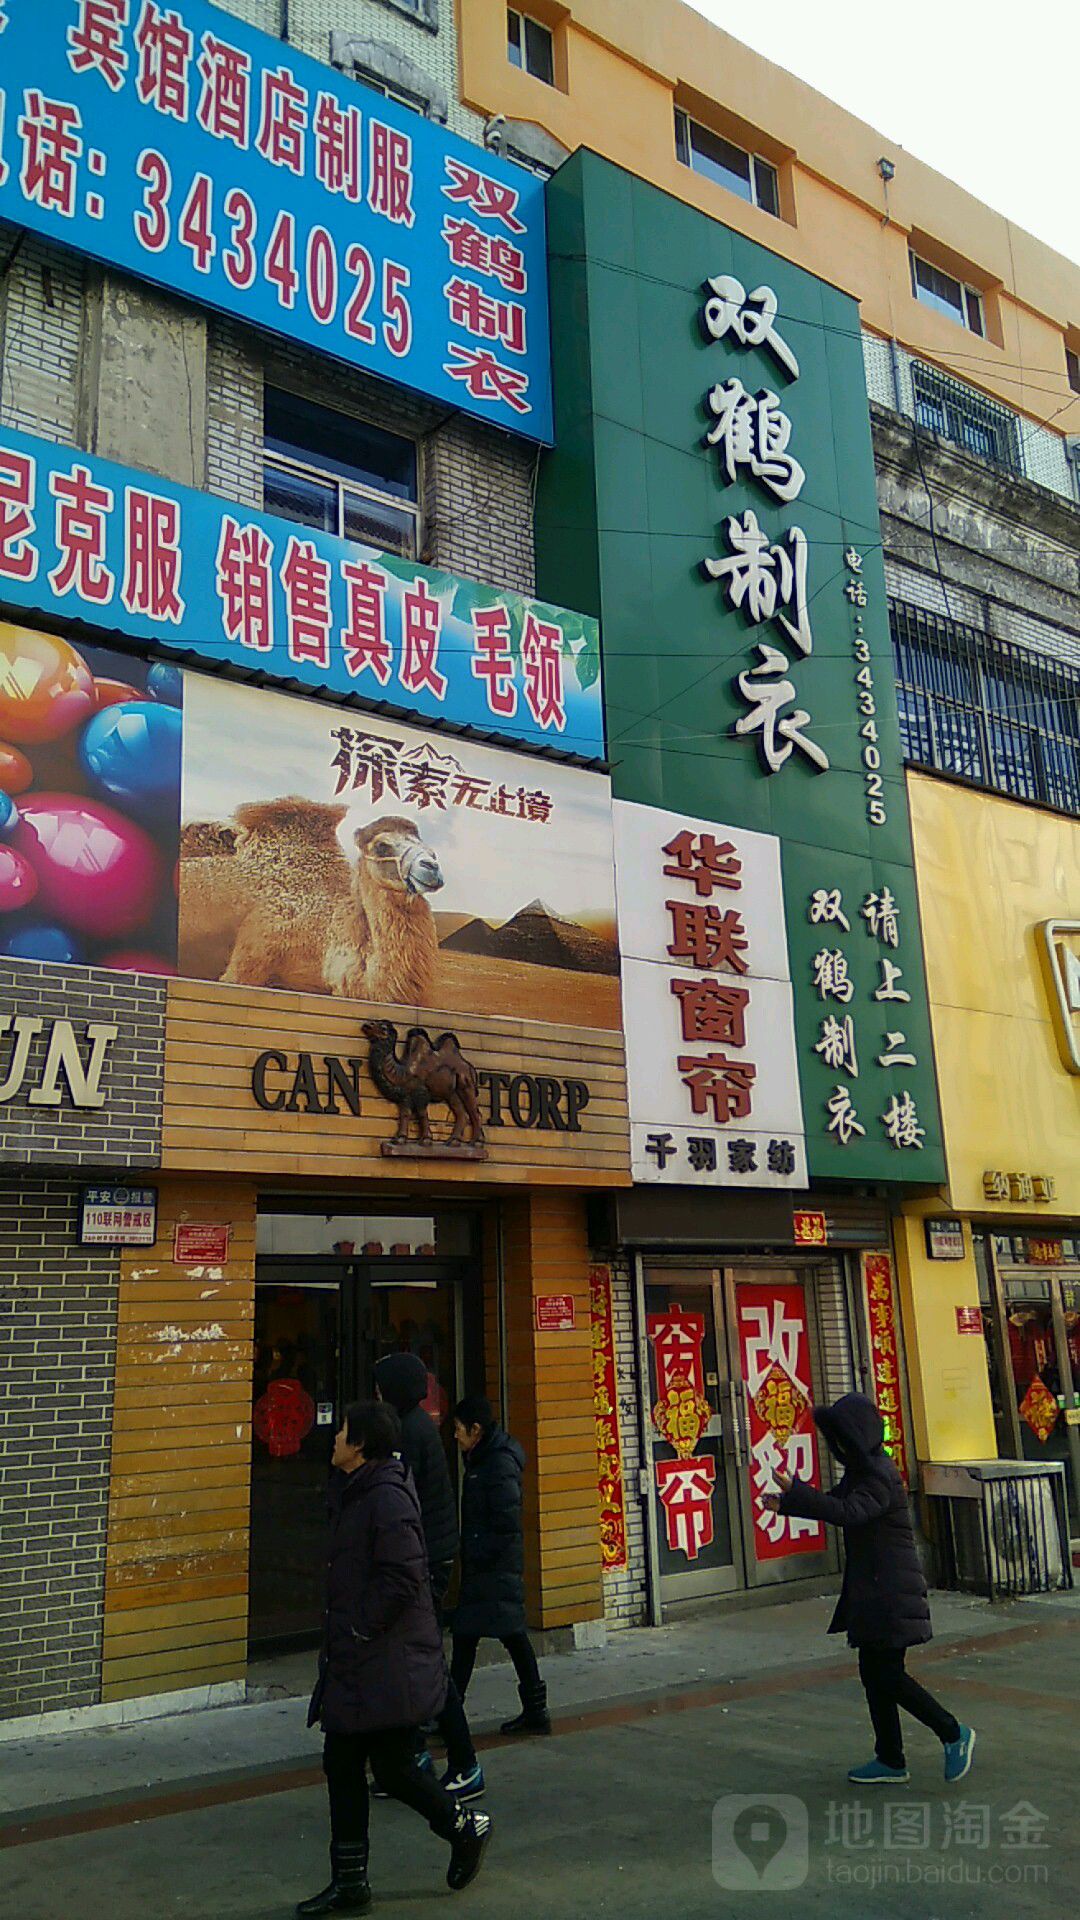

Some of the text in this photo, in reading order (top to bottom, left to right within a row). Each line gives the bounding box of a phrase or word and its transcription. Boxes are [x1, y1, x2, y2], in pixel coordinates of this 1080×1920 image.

[0, 88, 413, 358] 话:3434025
[66, 0, 416, 228] 宾馆酒店制服
[441, 155, 533, 415] 双鹤制衣
[215, 515, 447, 701] 销售真皮
[470, 603, 568, 732] 毛领
[704, 274, 830, 772] 双鹤制衣
[330, 725, 554, 825] 探索无止境
[252, 1051, 590, 1132] CAN TORP
[661, 829, 756, 1124] 华联窗帘
[810, 888, 866, 1145] 双鹤制衣
[862, 886, 926, 1150] 请上二楼
[644, 1132, 797, 1175] 千羽家纺
